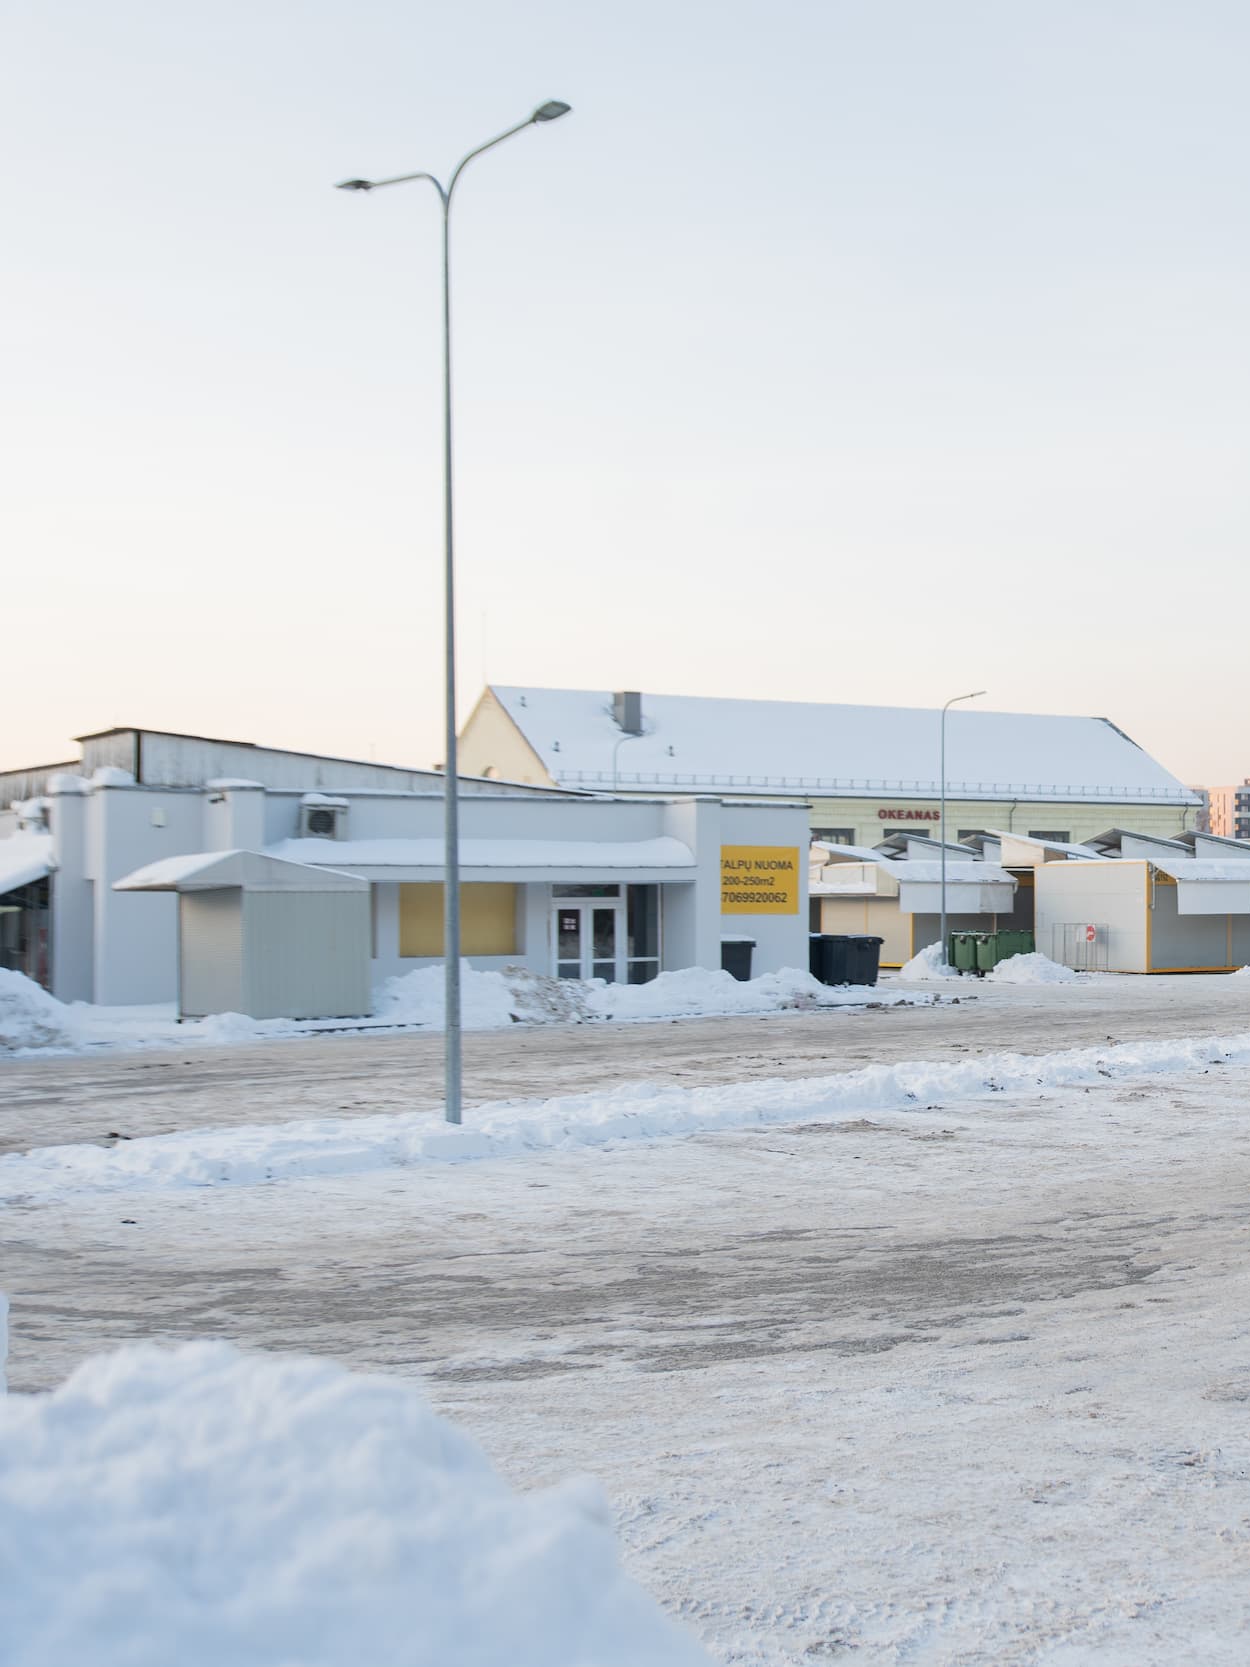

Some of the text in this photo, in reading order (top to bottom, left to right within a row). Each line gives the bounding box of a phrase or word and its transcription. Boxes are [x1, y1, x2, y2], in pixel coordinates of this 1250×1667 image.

[878, 809, 941, 821] OKEANAS
[755, 860, 793, 870] NUOMA
[722, 876, 775, 886] 200-250m2
[721, 892, 788, 903] 7069920062
